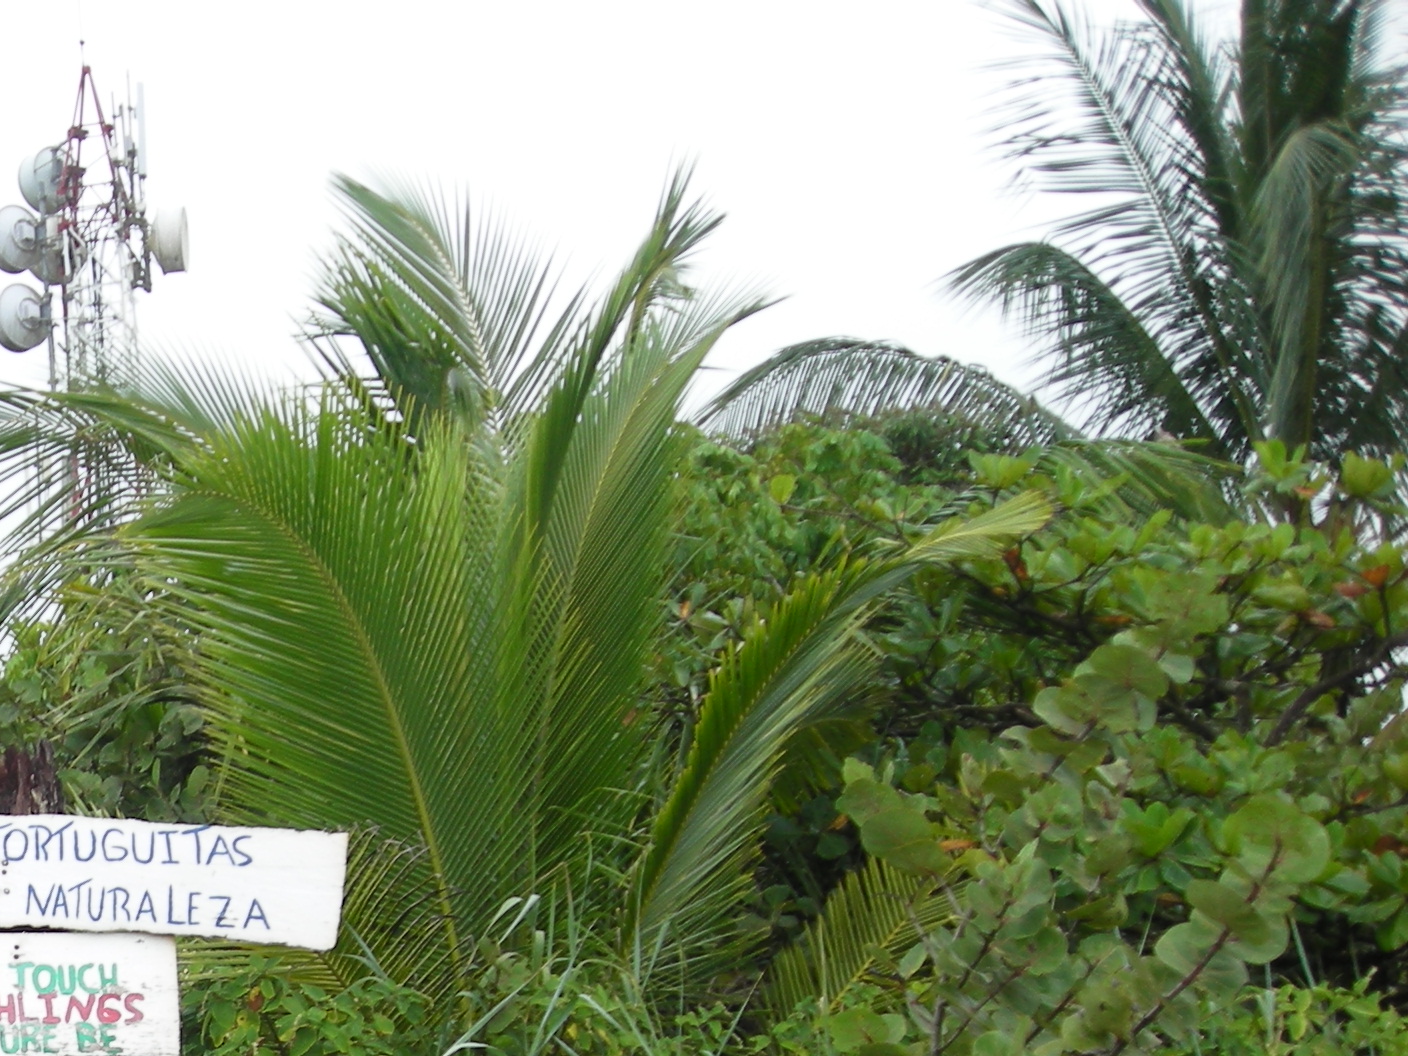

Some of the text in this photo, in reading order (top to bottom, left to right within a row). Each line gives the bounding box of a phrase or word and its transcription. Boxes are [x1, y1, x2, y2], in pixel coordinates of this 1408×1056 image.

[26, 878, 270, 930] NATURALEZA
[9, 961, 118, 995] TOUCH
[76, 1022, 123, 1056] BE
